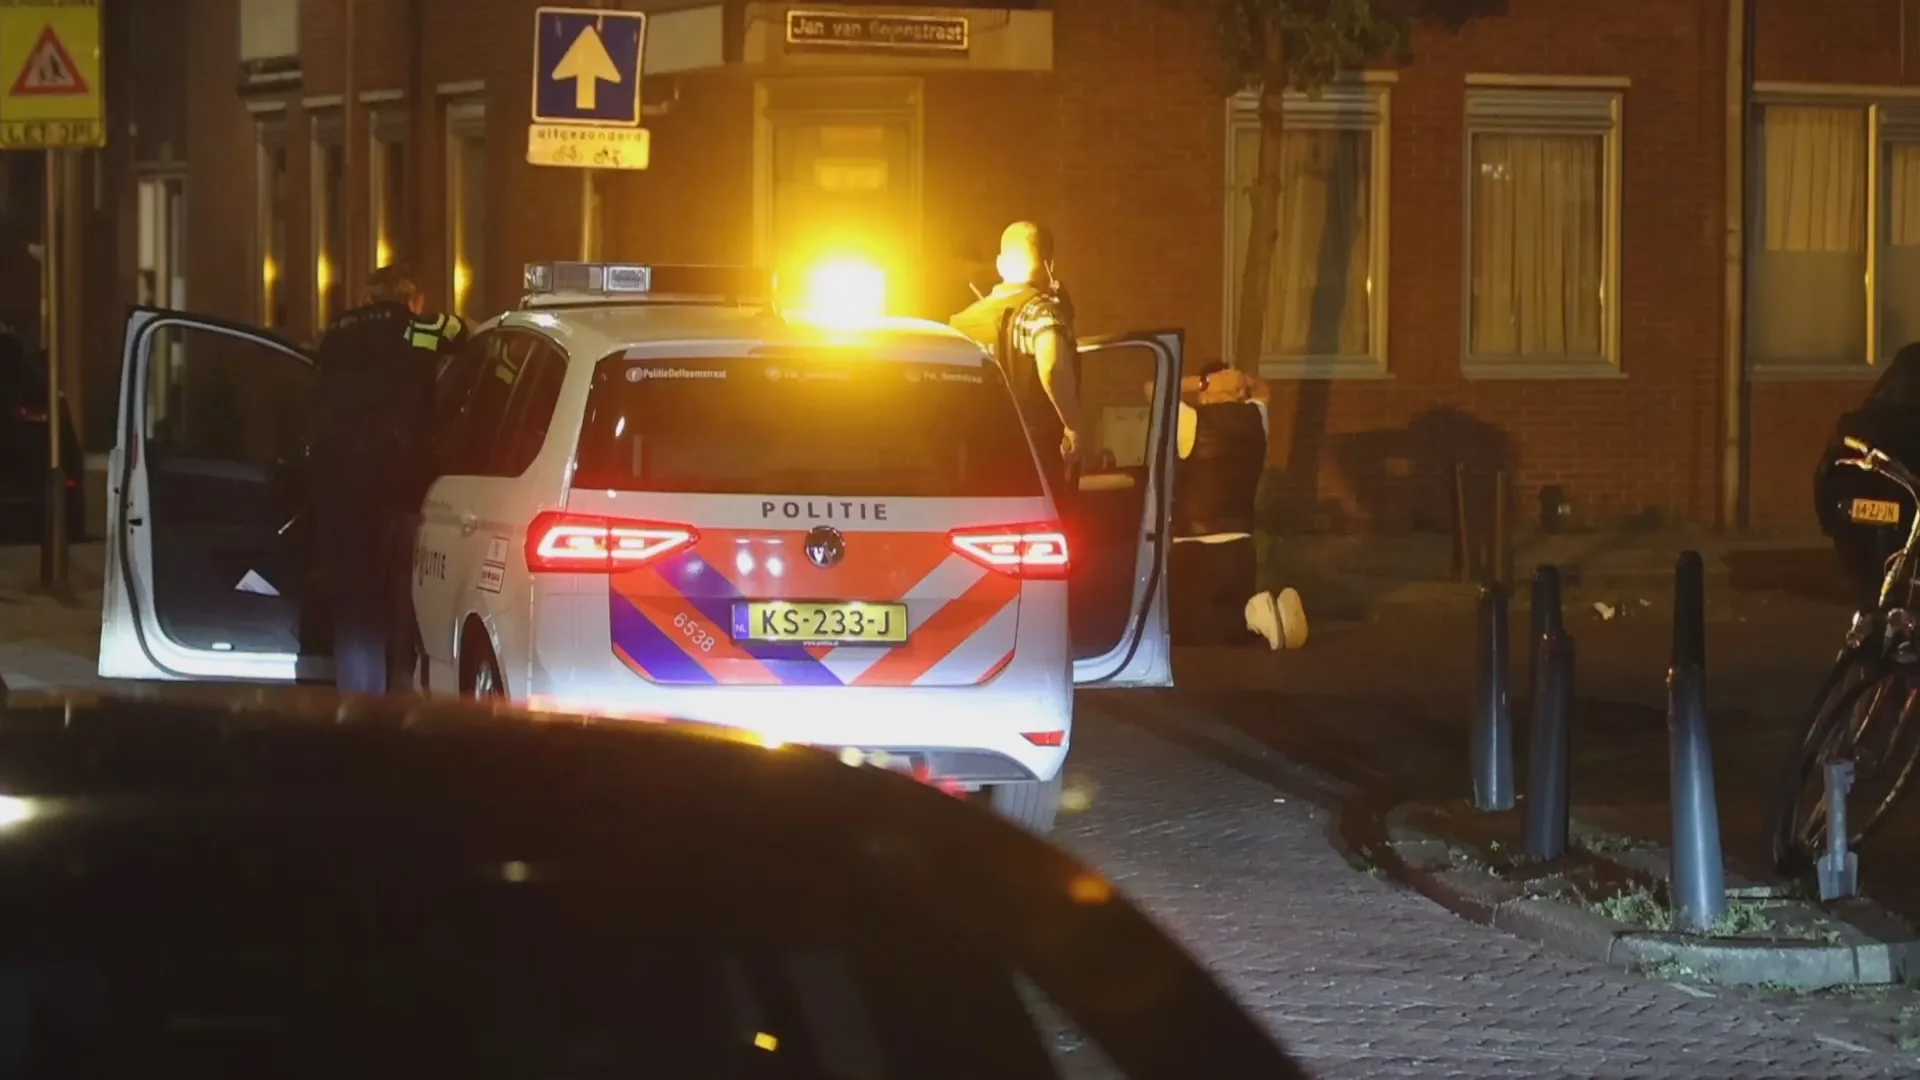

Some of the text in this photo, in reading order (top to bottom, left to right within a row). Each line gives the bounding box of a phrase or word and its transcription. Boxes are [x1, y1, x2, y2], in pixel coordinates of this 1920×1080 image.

[794, 18, 824, 35] Jan
[834, 23, 862, 37] van
[537, 127, 642, 143] uitgezonderd
[761, 501, 888, 520] POLITIE
[735, 608, 891, 636] NL KS-233-J
[673, 612, 715, 652] 6538
